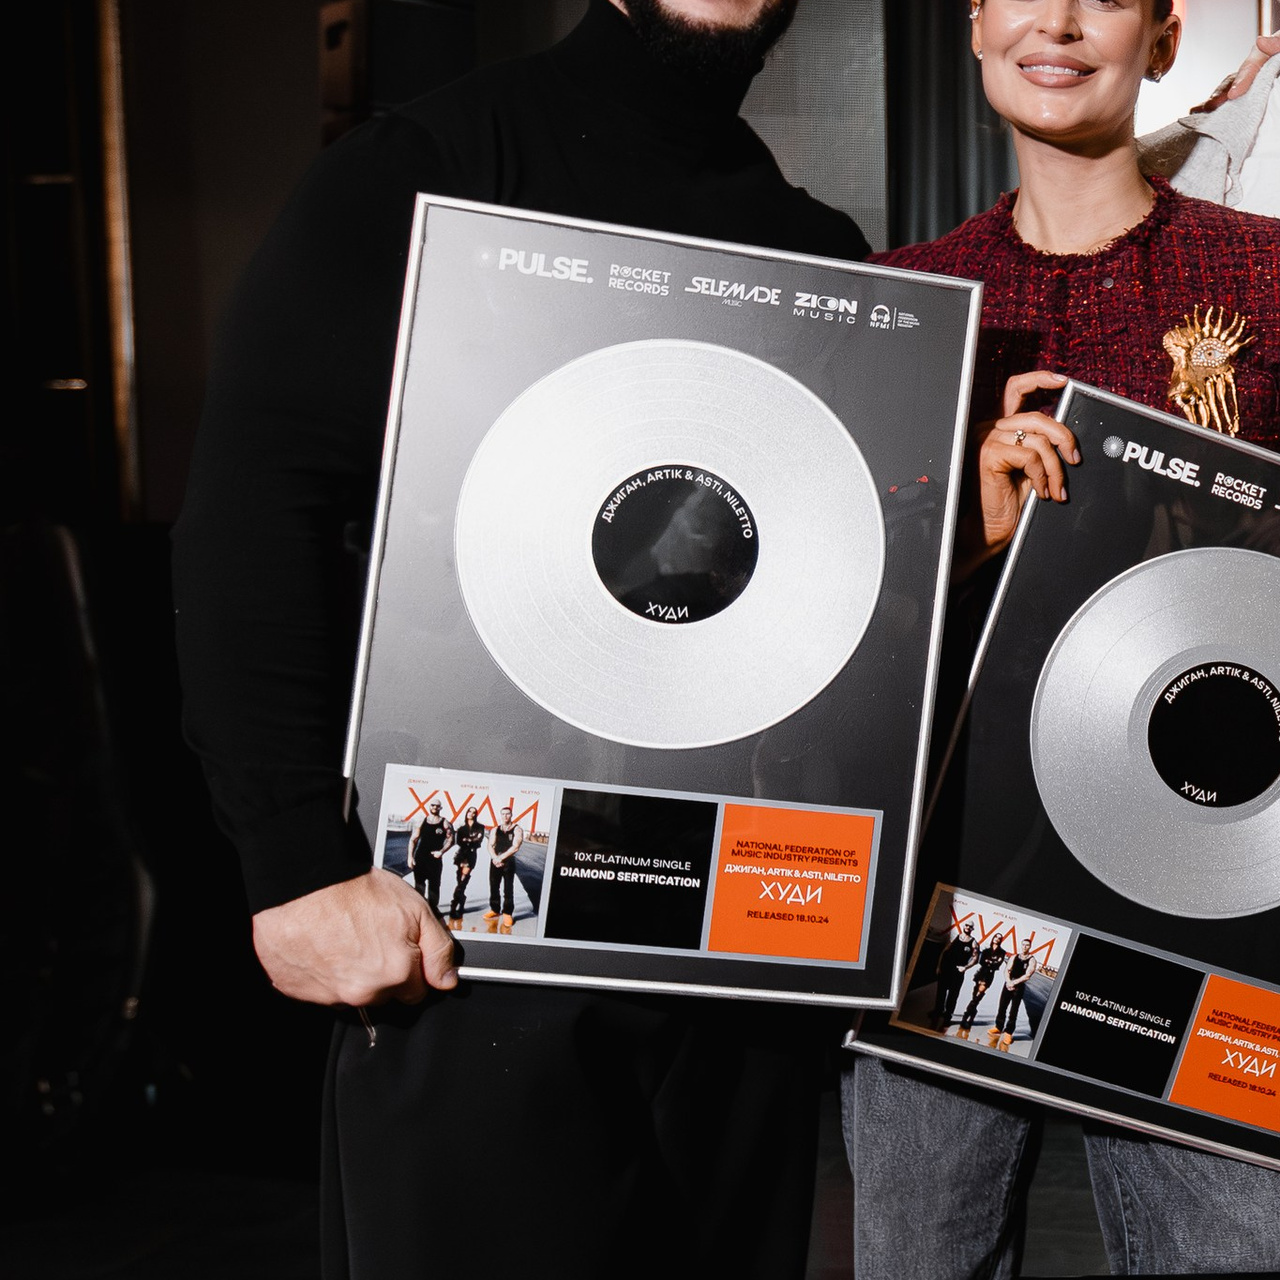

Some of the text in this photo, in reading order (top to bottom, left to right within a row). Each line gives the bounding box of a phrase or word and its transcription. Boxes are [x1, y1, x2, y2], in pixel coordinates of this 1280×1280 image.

[608, 277, 670, 296] RECORDS
[685, 276, 782, 305] SELFMADE
[794, 292, 858, 314] ZION
[793, 307, 856, 324] MUSIC
[602, 469, 753, 539] ДЖИГАН, ARTIK & ASTI, NILETTO
[1211, 484, 1263, 510] RECORDS
[645, 601, 689, 621] ХУДИ
[1164, 668, 1208, 705] ДЖИГАН,
[1209, 666, 1241, 678] ARTIK
[1241, 671, 1250, 681] &
[1250, 676, 1271, 700] ASTI,
[1180, 781, 1217, 803] ХУДИ
[731, 849, 858, 867] MUSIC INDUSTRY PRESENTS
[736, 840, 856, 858] NATIONAL FEDERATION OF
[574, 851, 692, 871] 10X PLATINUM SINGLE
[560, 866, 701, 889] DIAMOND SERTIFICATION
[724, 863, 862, 883] ДЖИГАН, ARTIK & ASTI, NILETTO
[758, 880, 823, 906] ХУДИ
[747, 910, 830, 924] RELEASED 18.10.24
[1075, 990, 1172, 1028] 10X PLATINUM SINGLE
[1211, 1008, 1251, 1026] NATIONAL
[1060, 1001, 1177, 1045] DIAMOND SERTIFICATION
[1205, 1015, 1232, 1029] MUSIC
[1232, 1023, 1272, 1040] INDUSTRY
[1196, 1027, 1232, 1045] ДЖИГАН,
[1232, 1038, 1255, 1051] ARTIK
[1254, 1044, 1261, 1052] &
[1260, 1046, 1280, 1058] ASTI,
[1221, 1048, 1277, 1078] ХУДИ
[1208, 1072, 1248, 1089] RELEASED
